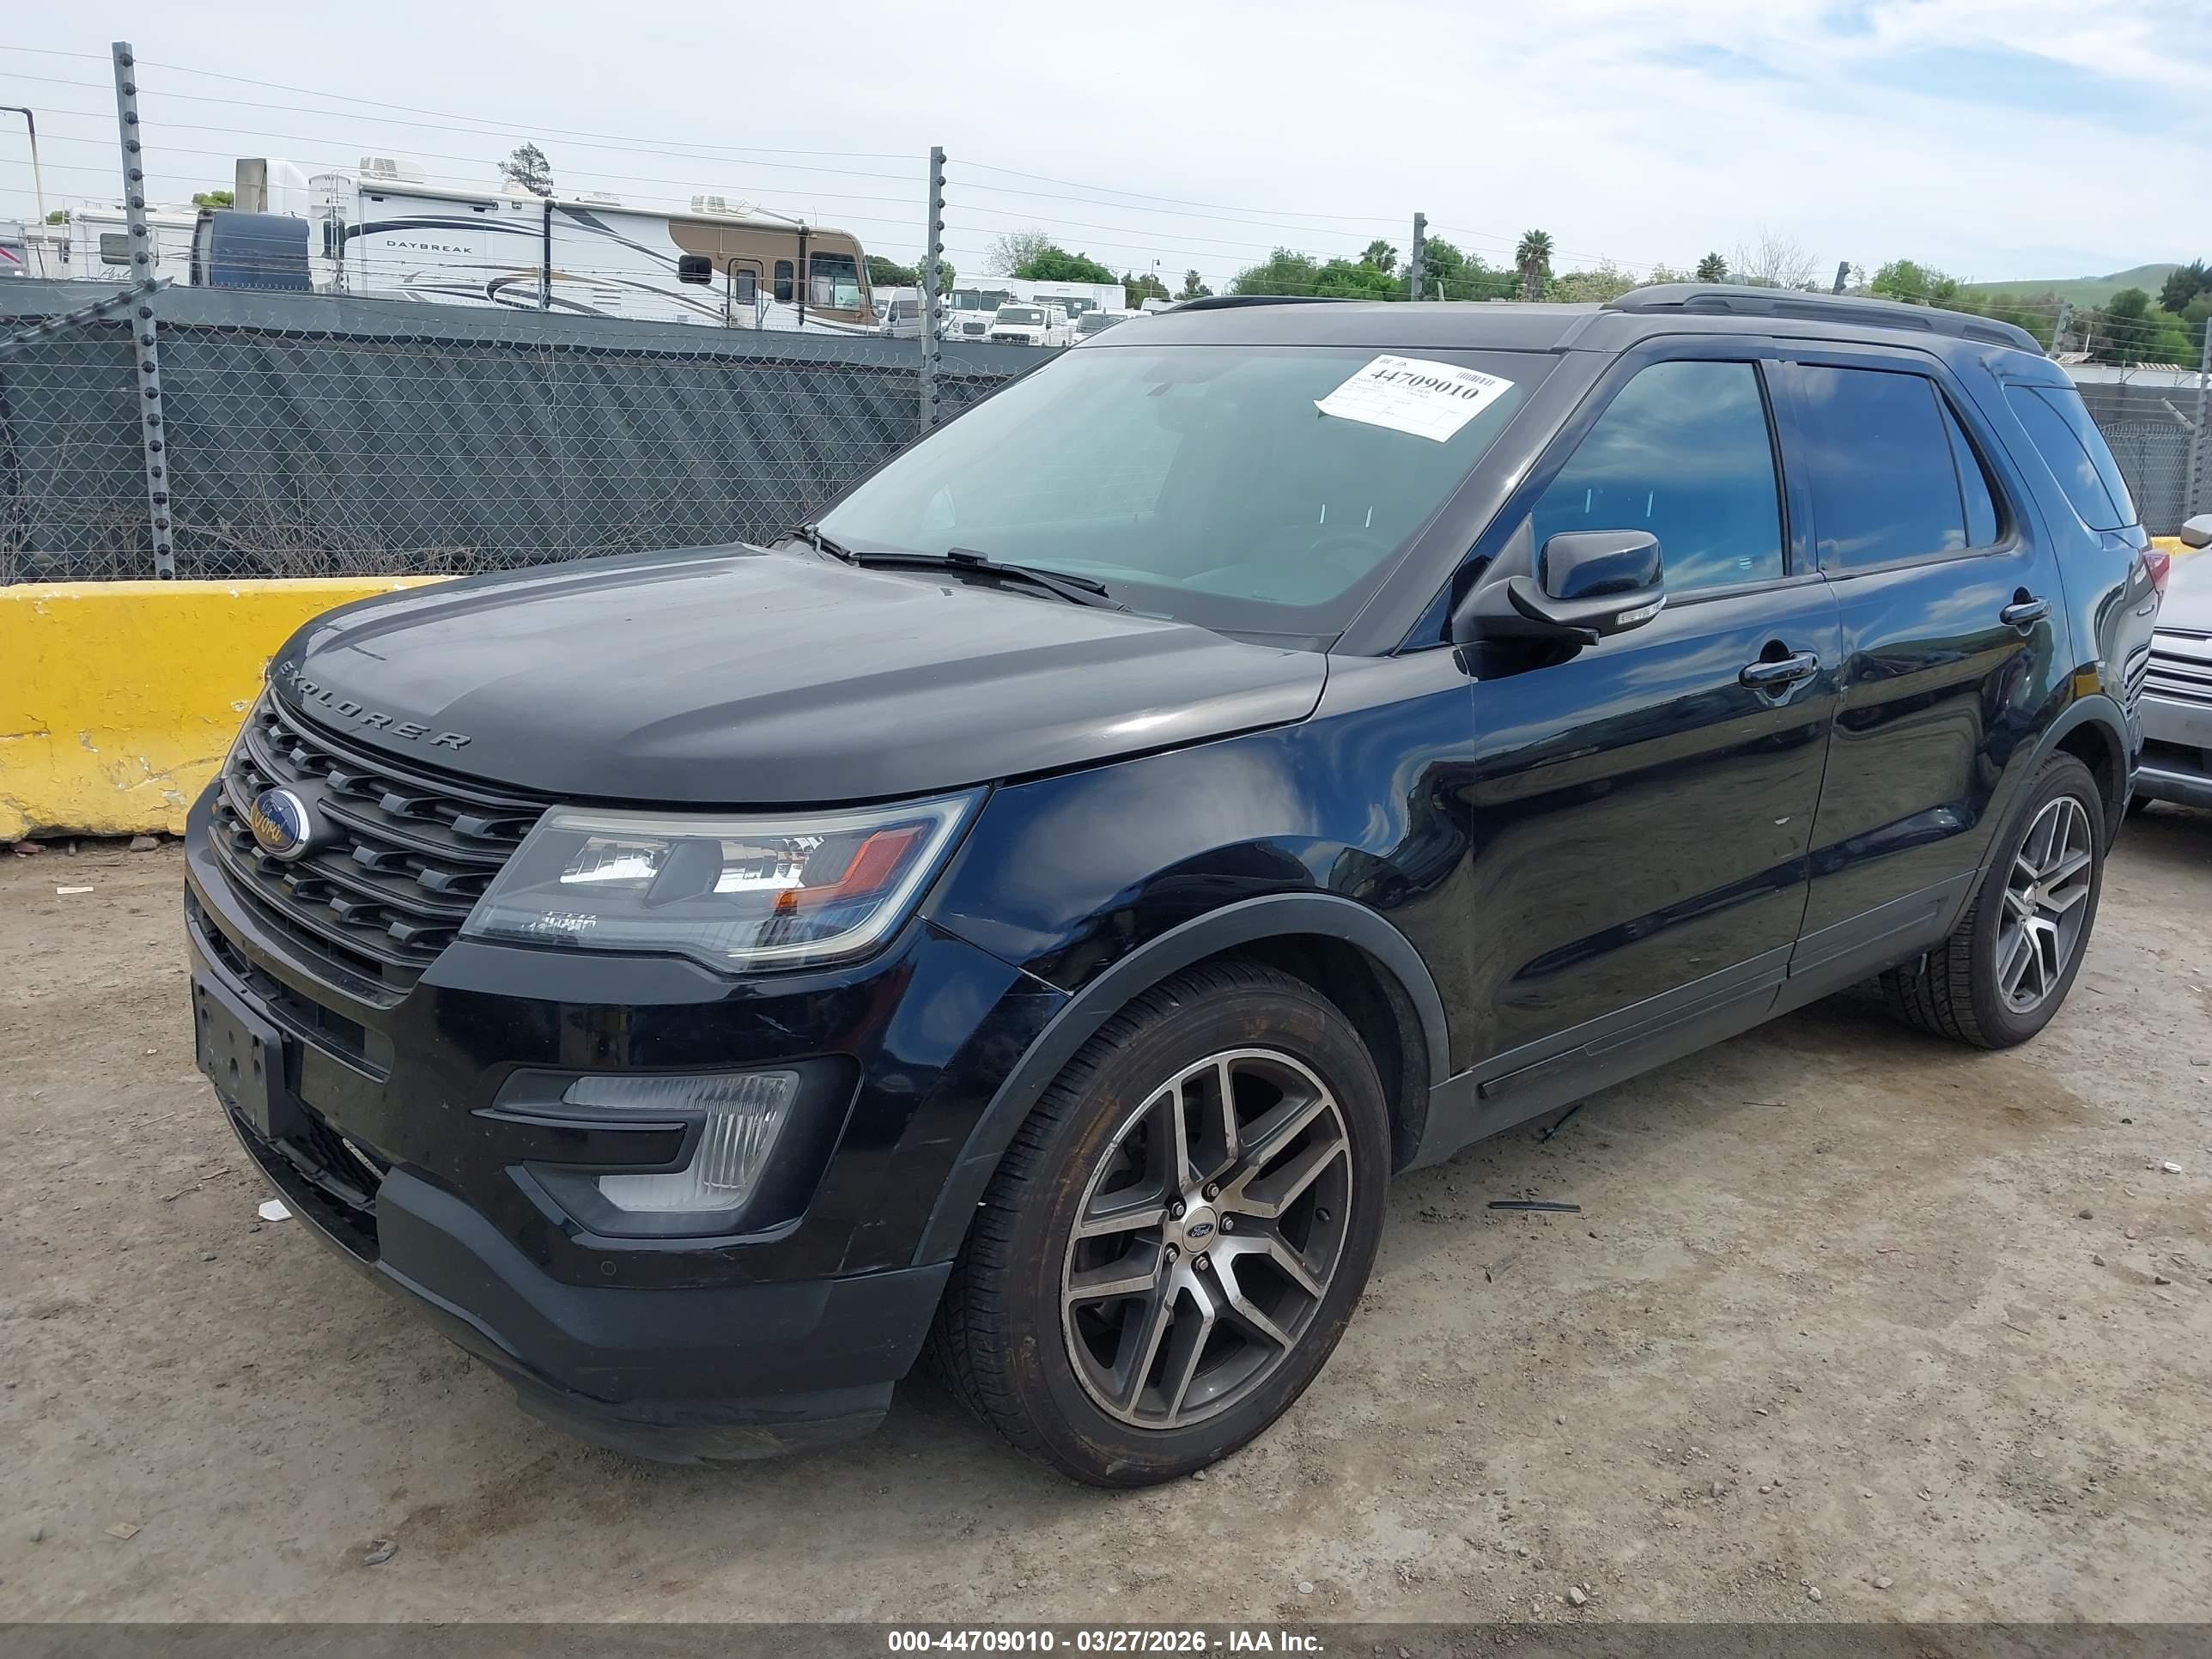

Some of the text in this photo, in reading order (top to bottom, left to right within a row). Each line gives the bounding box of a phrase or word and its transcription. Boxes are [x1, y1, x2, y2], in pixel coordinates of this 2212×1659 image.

[386, 240, 473, 253] DAYBREAK
[1370, 368, 1480, 400] 44709010
[280, 659, 473, 751] EXPLORER
[254, 798, 288, 842] Ford
[1191, 1224, 1211, 1237] Ford
